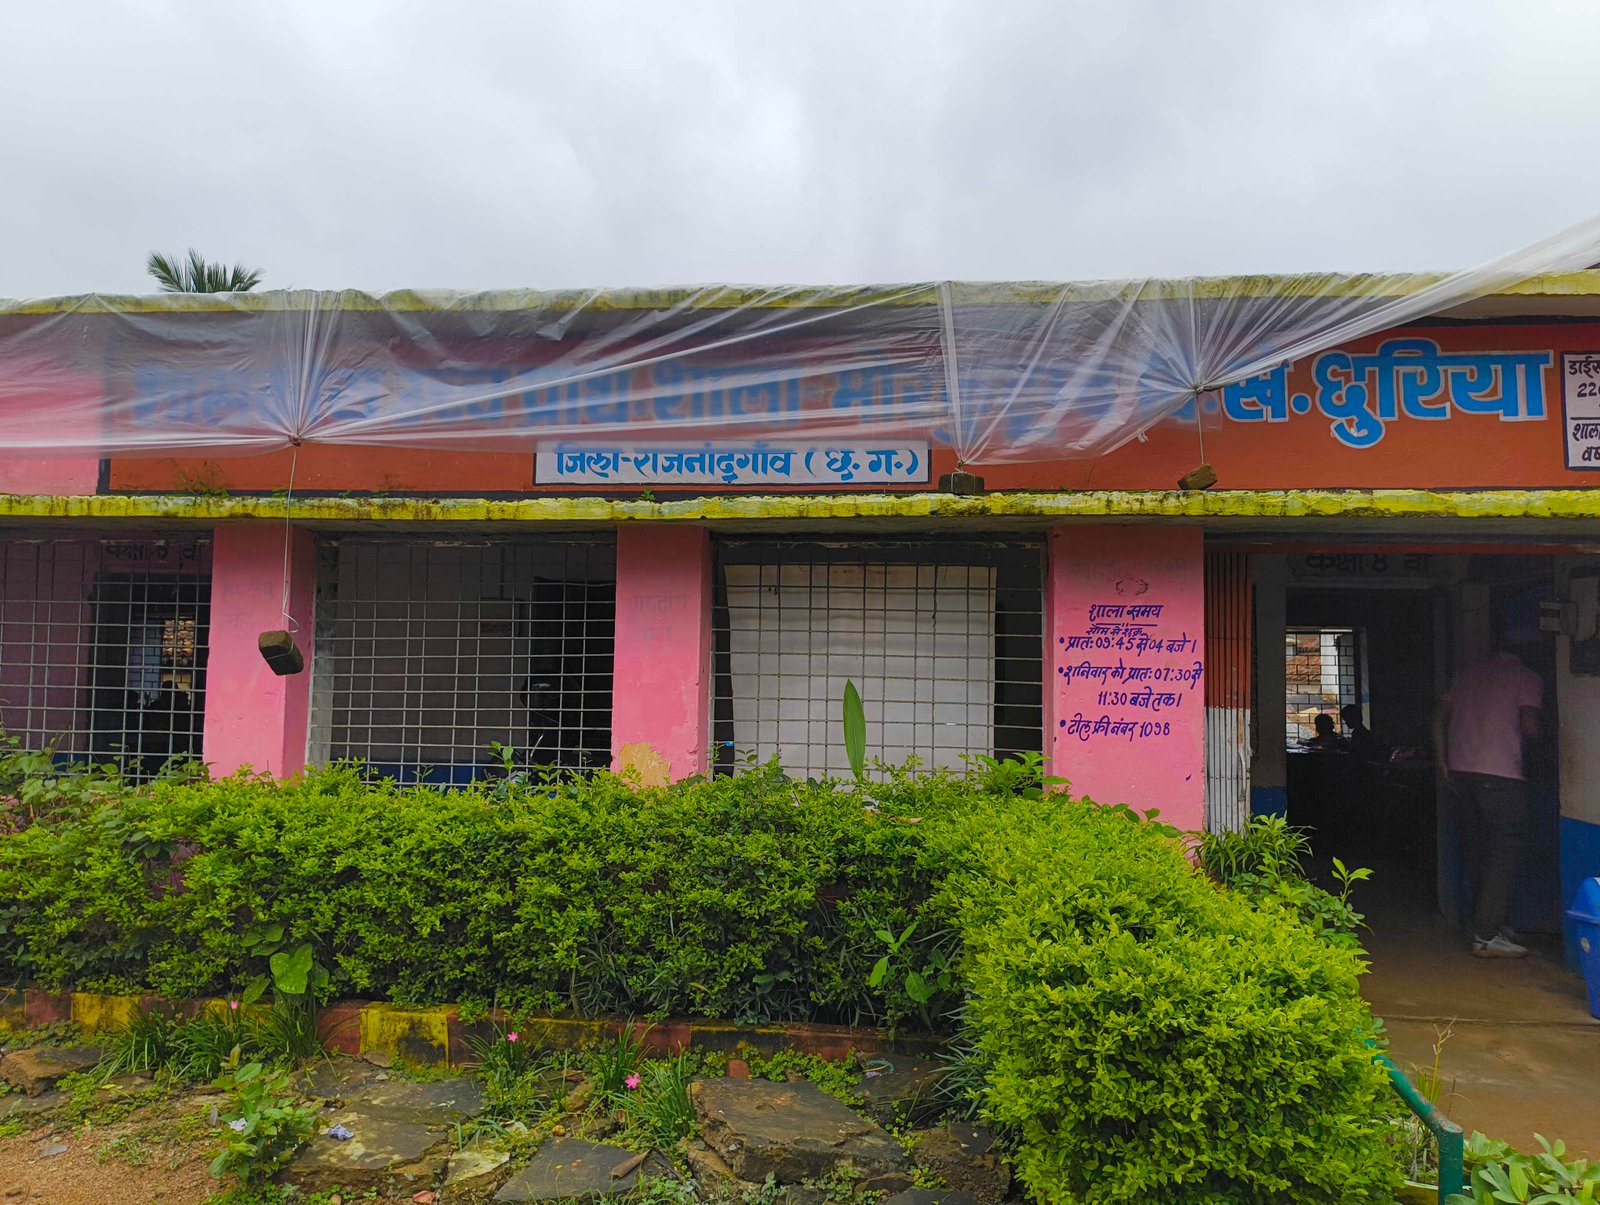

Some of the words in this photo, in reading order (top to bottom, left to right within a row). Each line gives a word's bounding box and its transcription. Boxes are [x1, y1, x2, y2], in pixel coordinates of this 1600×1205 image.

[1577, 381, 1600, 398] 22
[1088, 603, 1127, 622] शाला
[1126, 604, 1165, 621] समय
[1136, 632, 1150, 657] से
[1149, 638, 1164, 653] 04
[1063, 660, 1113, 686] शनिवार
[1110, 657, 1127, 680] को
[1153, 667, 1191, 682] 07:30
[1191, 660, 1204, 690] से
[1097, 690, 1128, 706] 11:30
[1128, 685, 1154, 708] बजे
[1091, 714, 1112, 737] फ्री
[1110, 717, 1139, 742] नंबर
[1139, 721, 1171, 738] 1098
